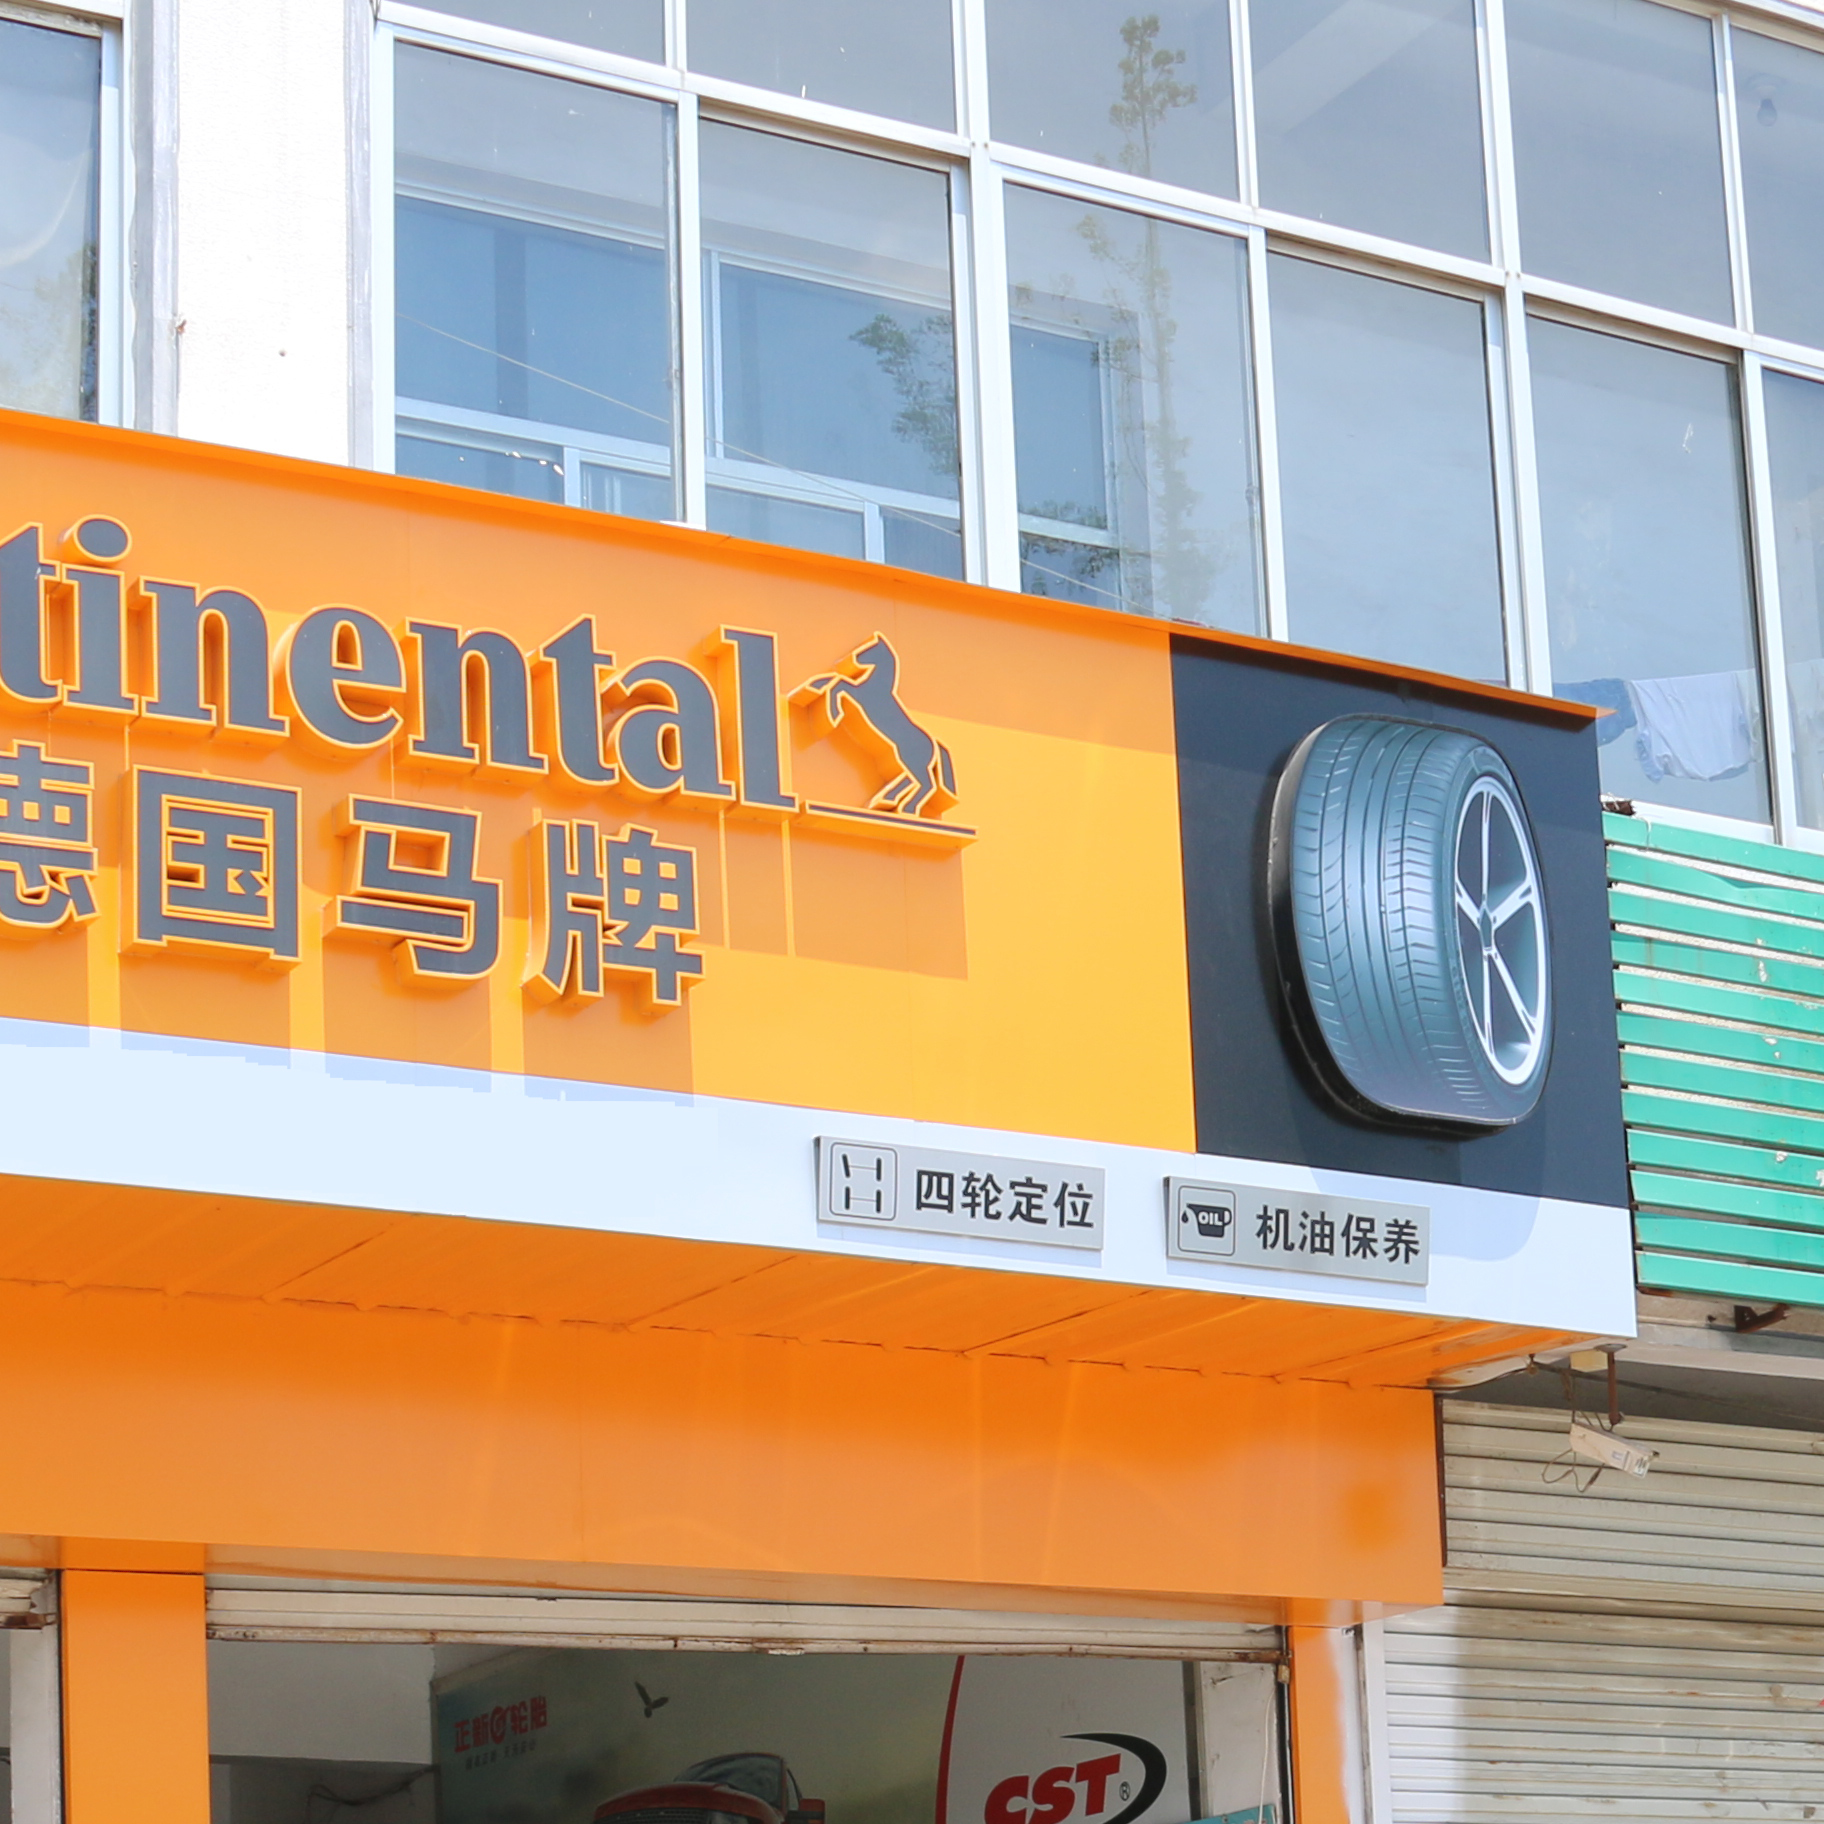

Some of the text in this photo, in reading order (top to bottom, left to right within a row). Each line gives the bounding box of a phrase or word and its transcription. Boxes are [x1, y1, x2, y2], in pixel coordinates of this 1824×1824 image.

[915, 1167, 1095, 1229] 四轮定位
[1197, 1212, 1224, 1224] OIL
[1256, 1204, 1420, 1265] 机油保养
